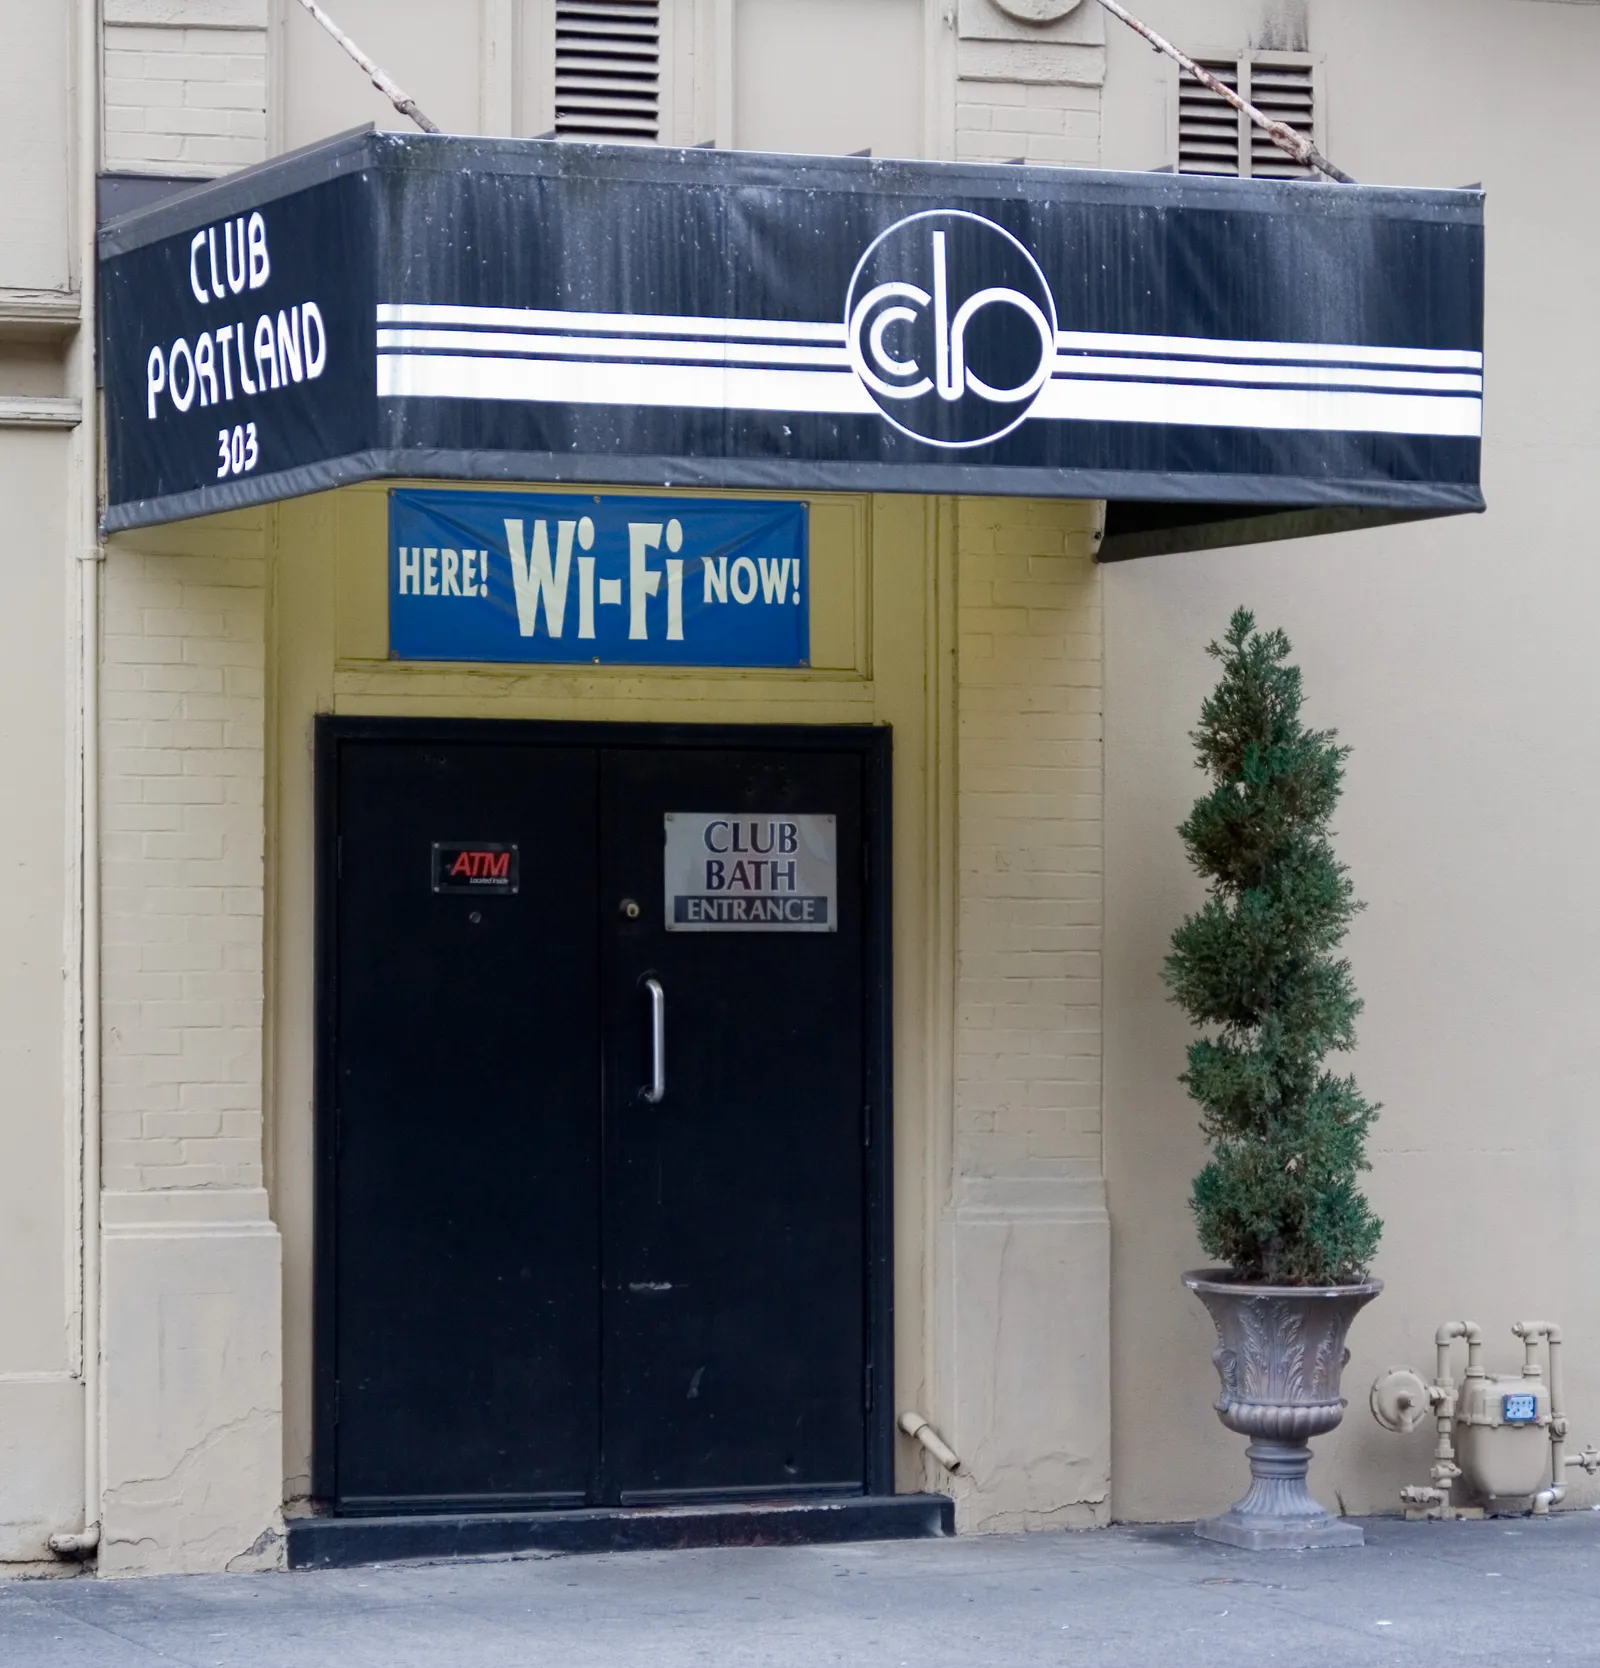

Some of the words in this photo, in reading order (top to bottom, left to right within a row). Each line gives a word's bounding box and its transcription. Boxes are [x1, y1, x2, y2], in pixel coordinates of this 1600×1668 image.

[190, 211, 270, 304] CLUB
[147, 301, 327, 419] PORTLAND
[216, 422, 259, 478] 303
[399, 546, 489, 598] HERE!
[504, 515, 685, 641] Wi-Fi
[702, 556, 801, 606] NOW!
[703, 820, 799, 854] CLUB
[450, 851, 511, 877] ATM
[705, 859, 797, 892] BATH
[687, 899, 815, 921] ENTRANCE
